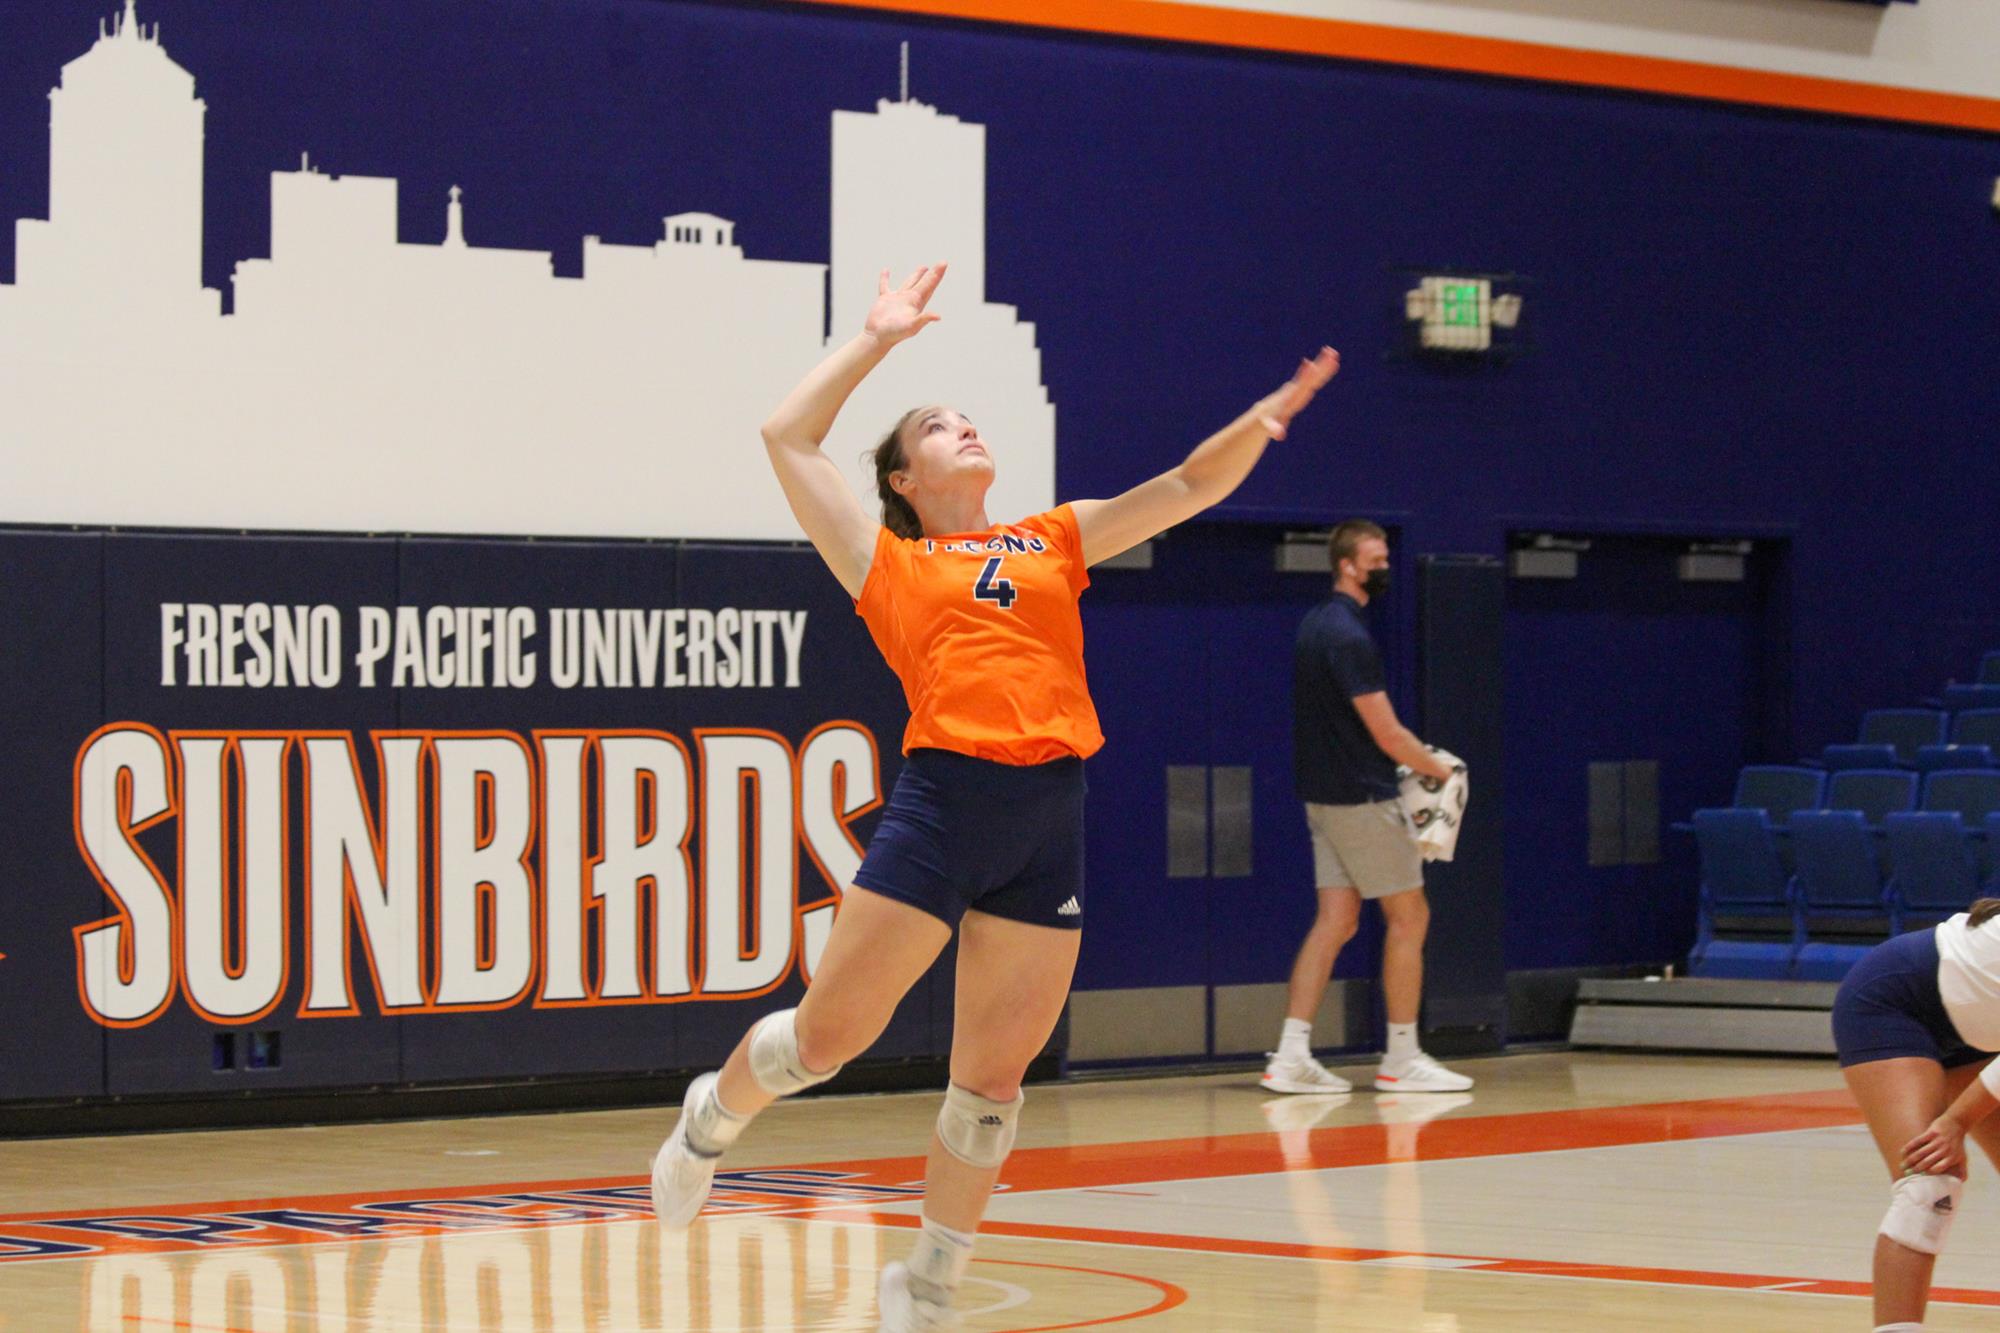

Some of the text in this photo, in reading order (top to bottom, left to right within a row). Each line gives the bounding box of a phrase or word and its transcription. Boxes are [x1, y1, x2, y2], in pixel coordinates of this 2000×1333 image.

[973, 556, 1017, 609] 4
[160, 602, 808, 688] FRESNO PACIFIC UNIVERSITY
[72, 719, 884, 1029] SUNBIRDS
